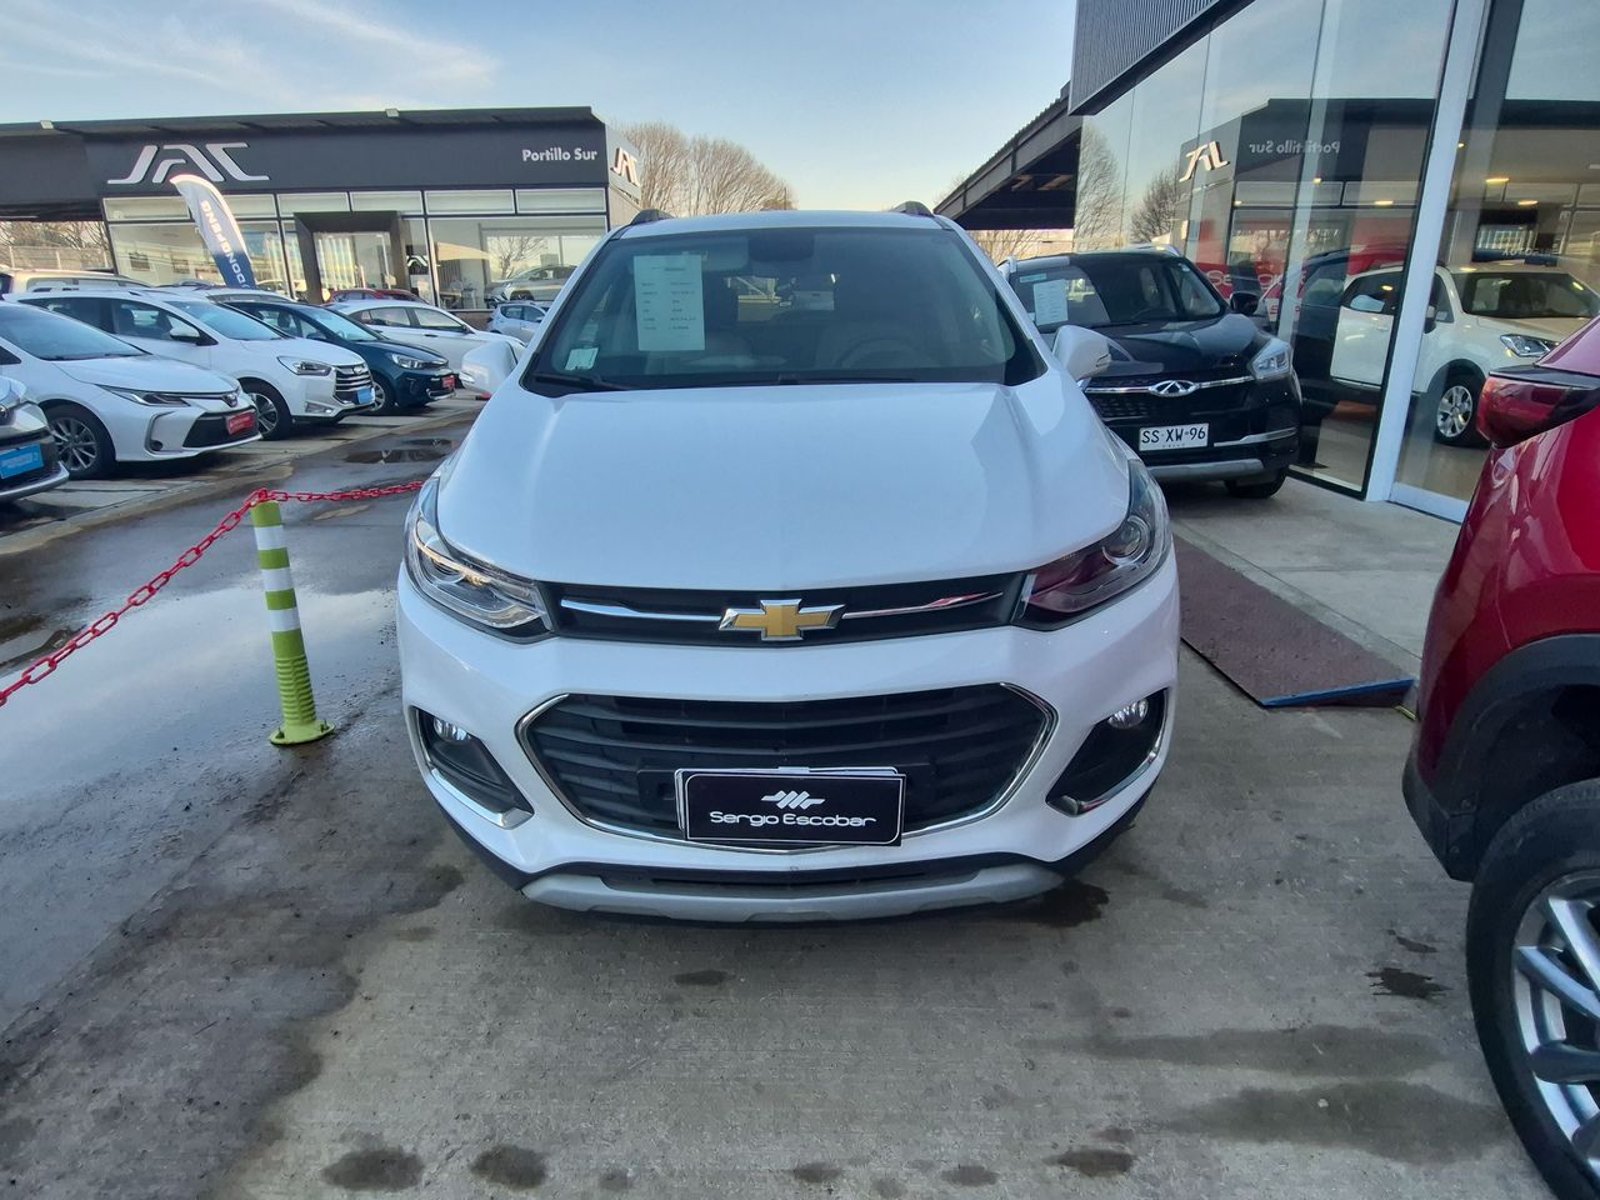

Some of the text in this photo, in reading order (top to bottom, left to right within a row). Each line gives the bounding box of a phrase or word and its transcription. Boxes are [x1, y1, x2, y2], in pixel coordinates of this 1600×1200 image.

[521, 147, 598, 162] Portillo Sur
[200, 200, 246, 284] DONGFENG
[709, 811, 876, 828] Sergio Escobar
